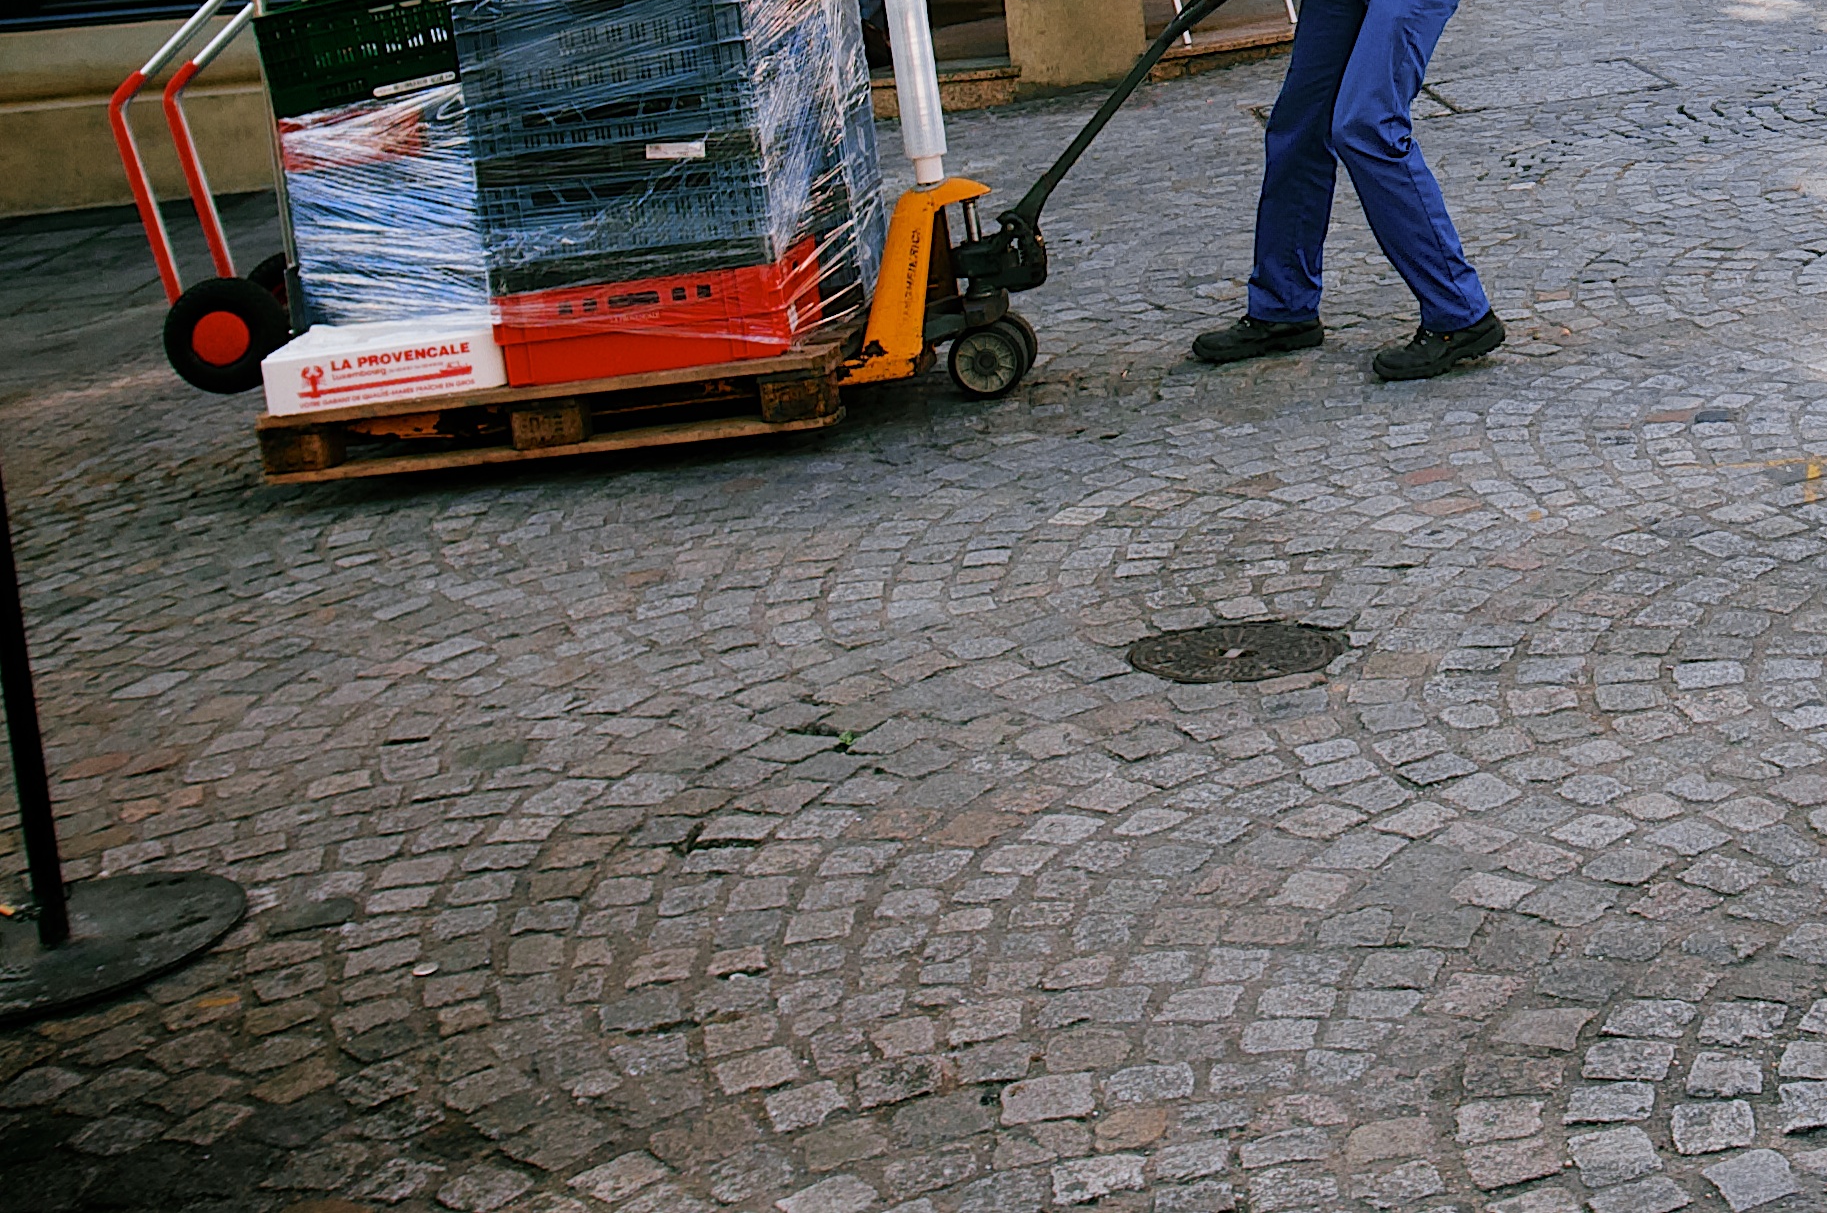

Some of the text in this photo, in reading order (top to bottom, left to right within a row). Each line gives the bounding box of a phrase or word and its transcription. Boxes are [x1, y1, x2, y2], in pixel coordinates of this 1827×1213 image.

[330, 359, 352, 372] LA
[357, 342, 471, 369] PROVENCALE
[332, 367, 387, 382] Luxembourg
